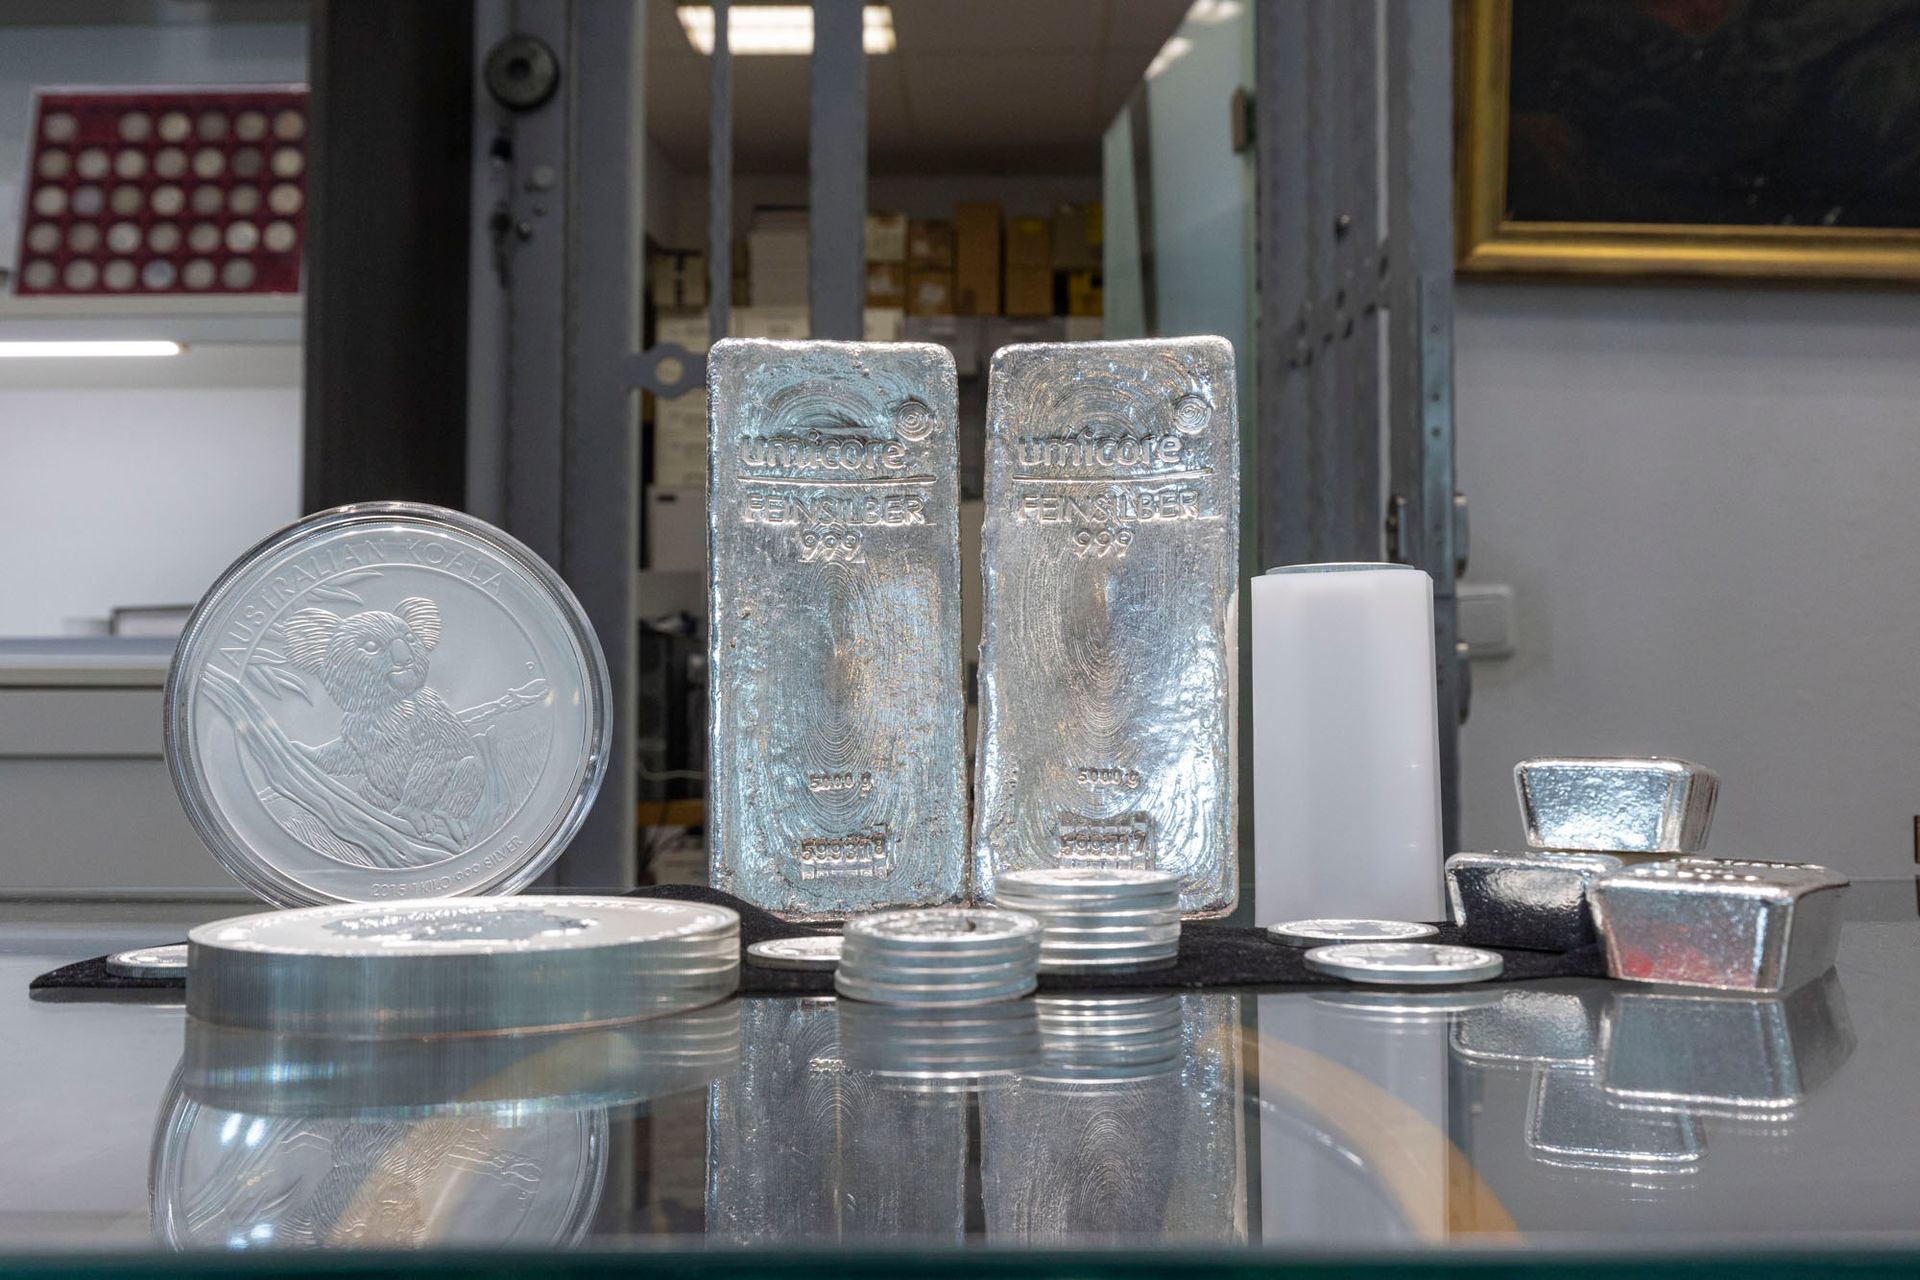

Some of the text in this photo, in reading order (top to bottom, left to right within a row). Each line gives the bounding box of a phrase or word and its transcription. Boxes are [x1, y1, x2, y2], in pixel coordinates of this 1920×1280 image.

[738, 428, 906, 470] umicore
[1018, 427, 1184, 466] umicore
[744, 492, 926, 527] FEINSILBER
[1017, 488, 1201, 525] FEINSILBER
[799, 529, 863, 562] 999
[1072, 527, 1134, 560] 999
[218, 538, 502, 668] AUSTRALIAN KOALA
[483, 834, 524, 870] SILVER
